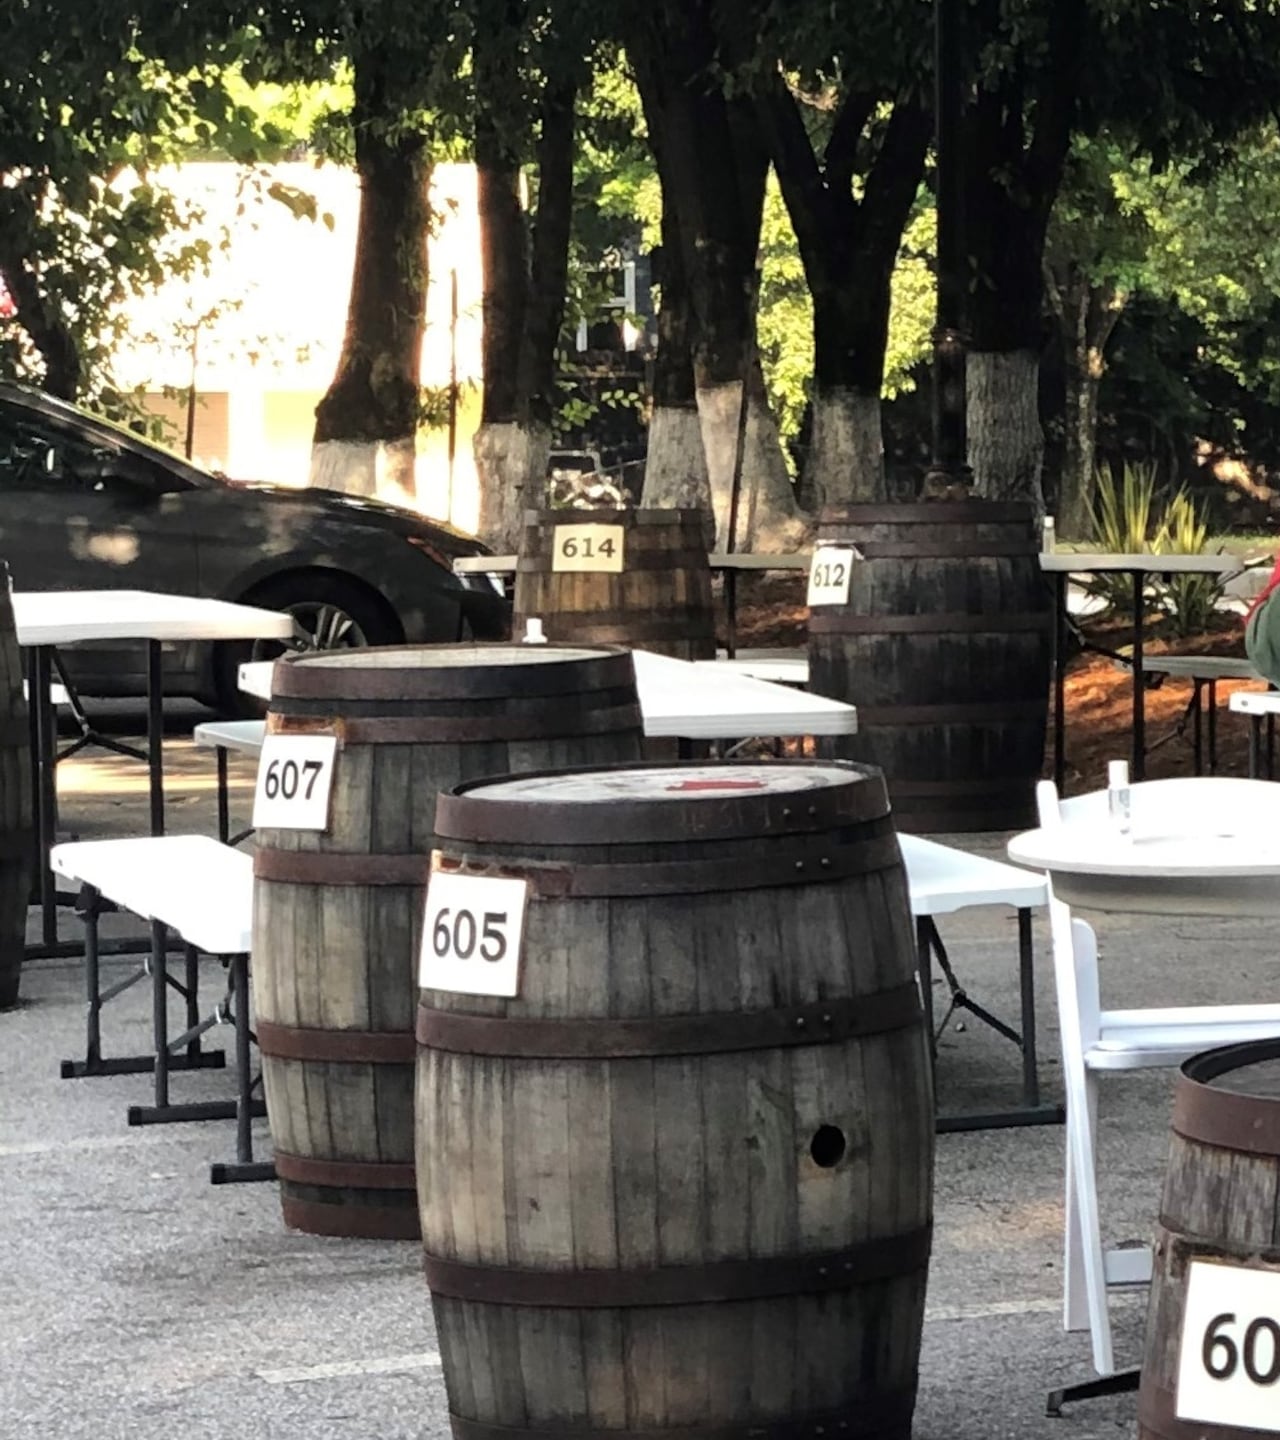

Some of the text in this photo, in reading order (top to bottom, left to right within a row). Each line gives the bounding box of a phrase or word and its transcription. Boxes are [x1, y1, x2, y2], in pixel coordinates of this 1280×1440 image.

[562, 537, 616, 558] 614
[813, 563, 845, 587] 612
[265, 759, 324, 800] 607
[433, 907, 507, 962] 605
